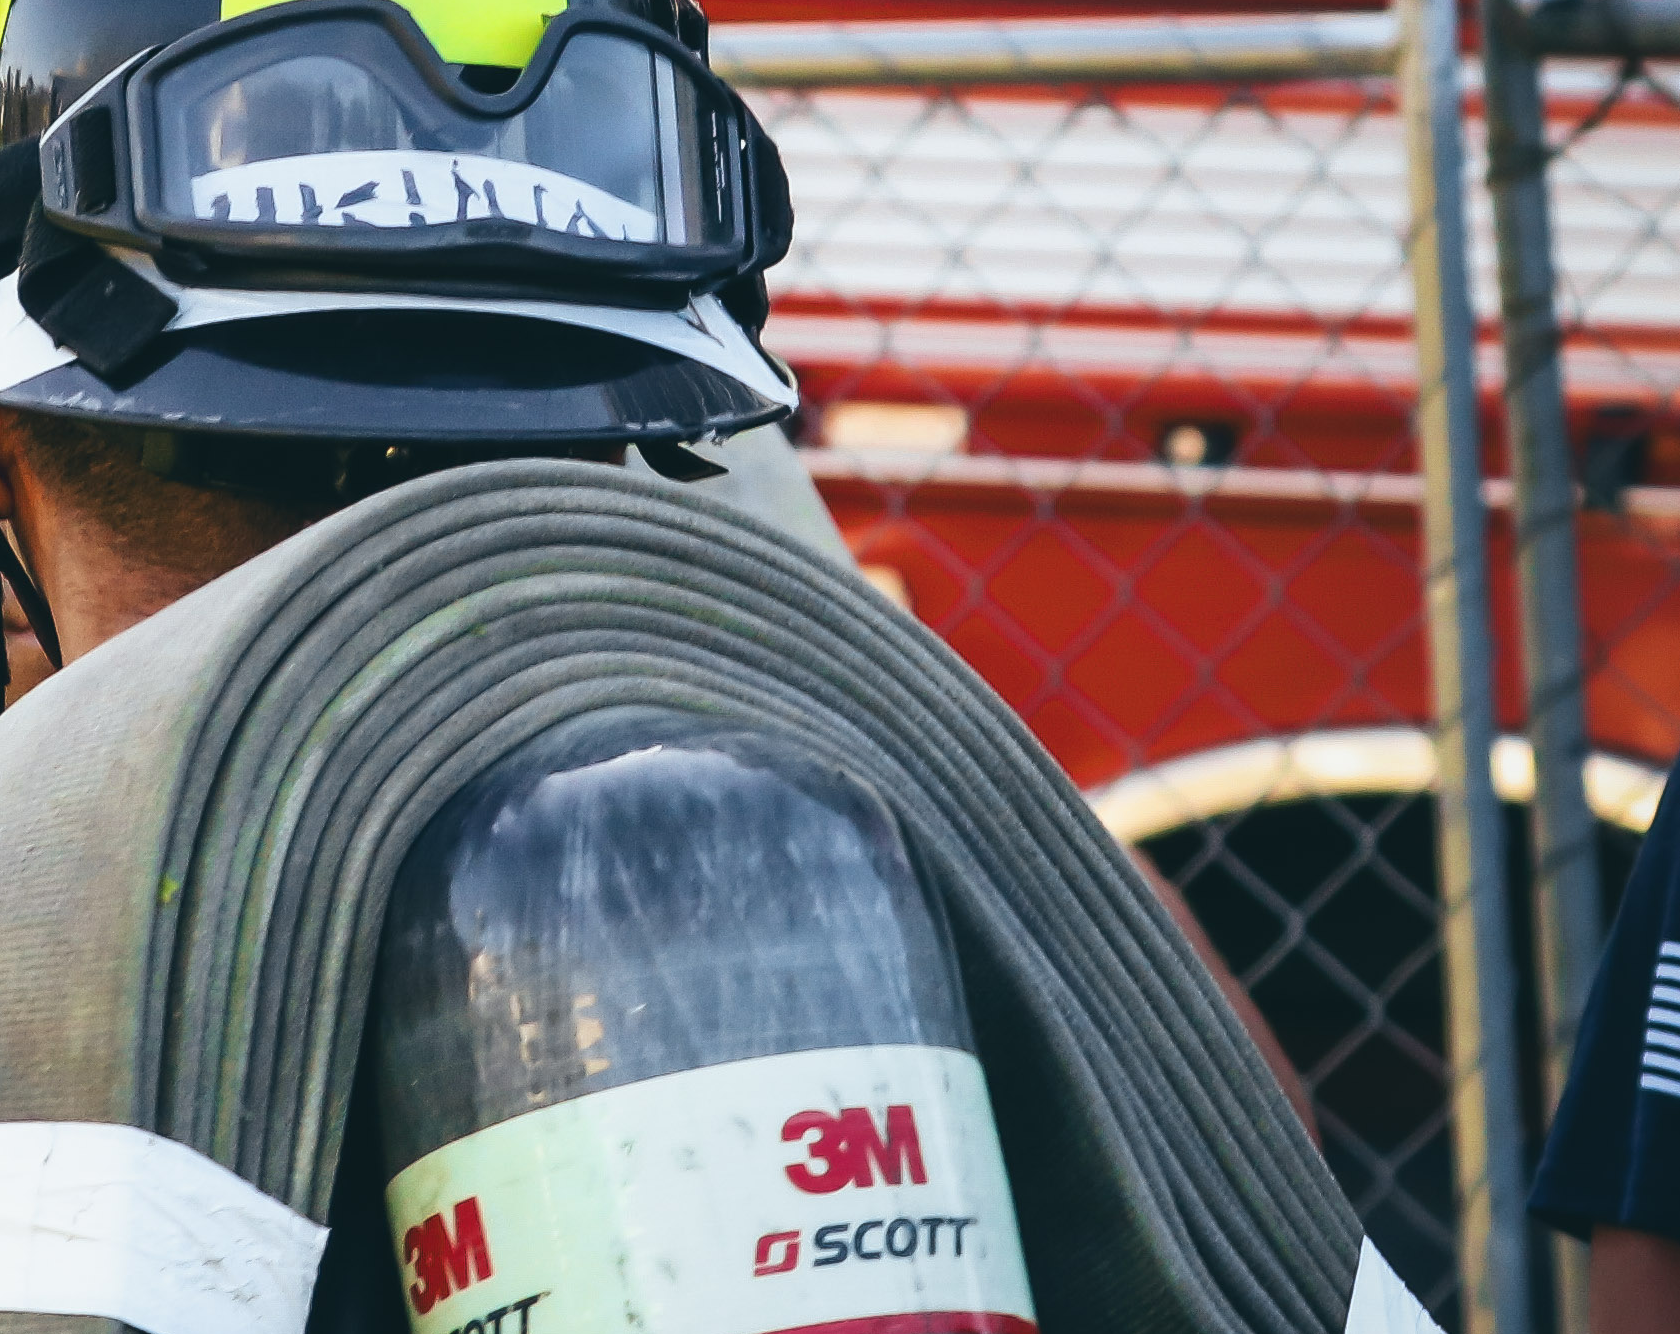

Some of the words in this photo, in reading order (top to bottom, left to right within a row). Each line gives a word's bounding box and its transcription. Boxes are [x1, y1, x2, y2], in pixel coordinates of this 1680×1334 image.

[780, 1104, 929, 1195] 3M
[403, 1195, 494, 1316] 3M
[812, 1215, 979, 1268] SCOTT
